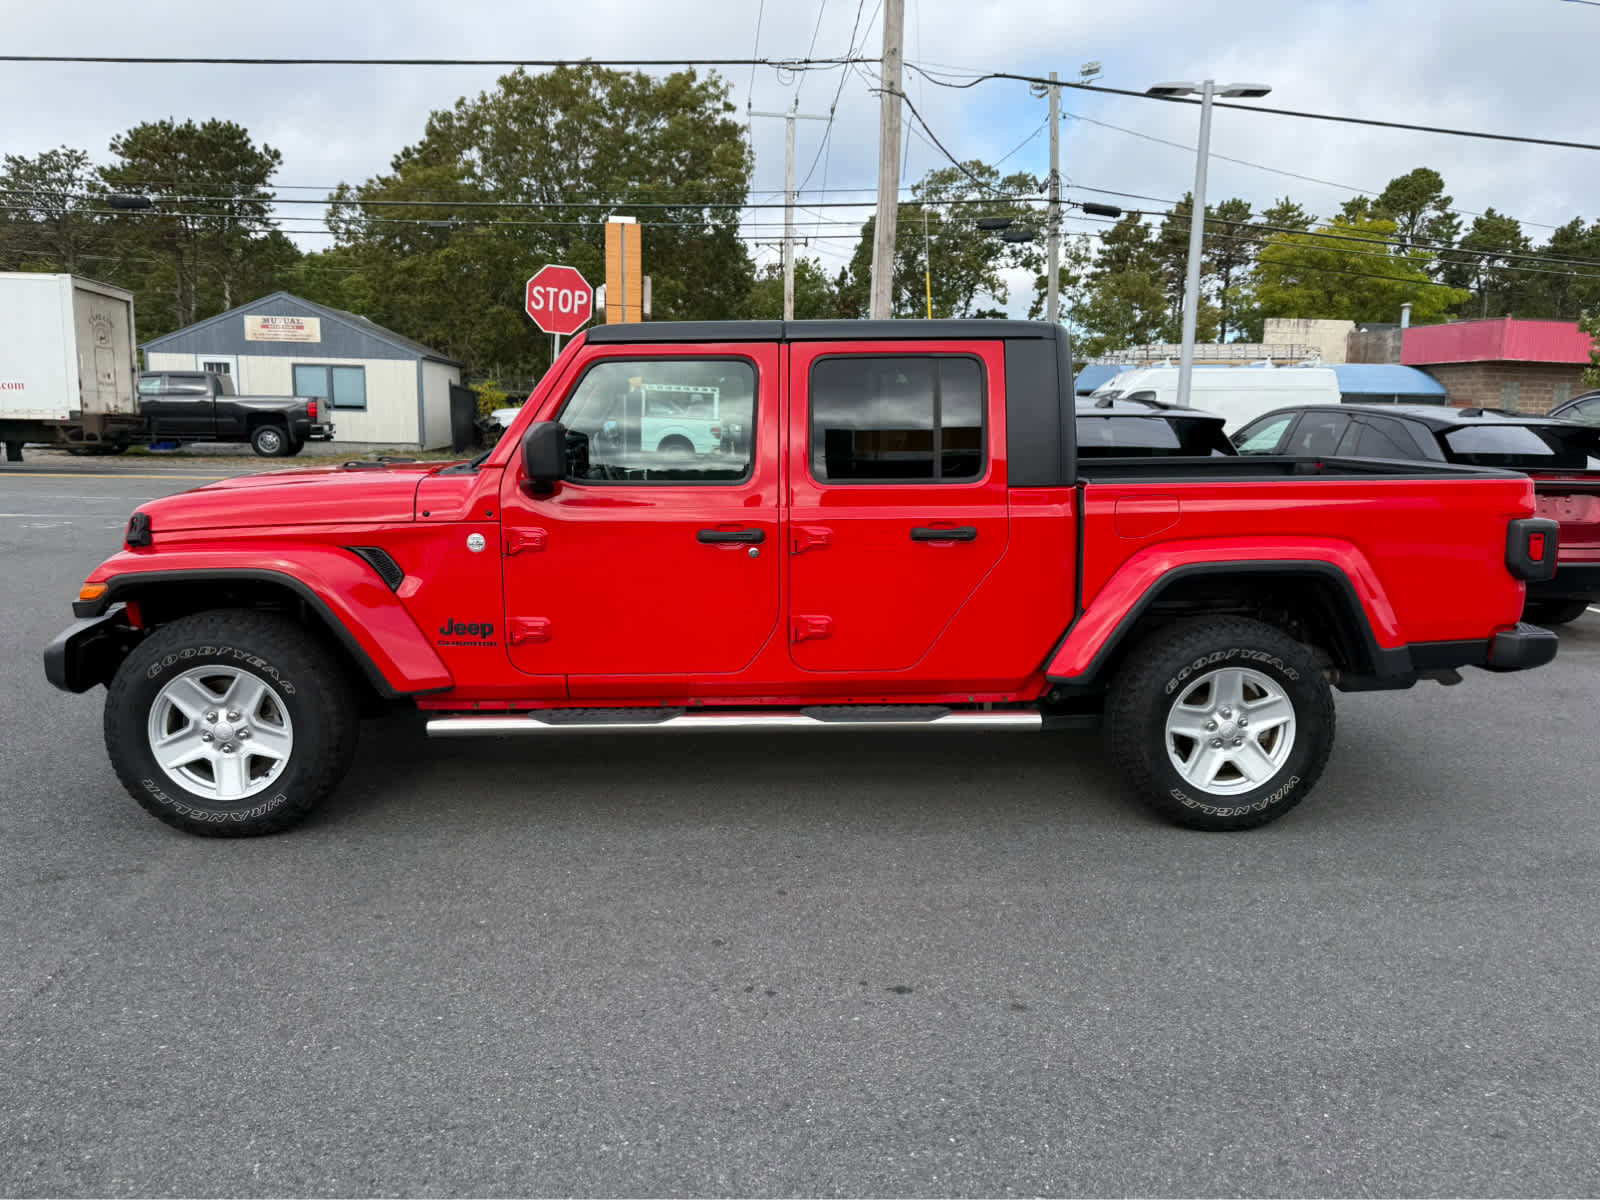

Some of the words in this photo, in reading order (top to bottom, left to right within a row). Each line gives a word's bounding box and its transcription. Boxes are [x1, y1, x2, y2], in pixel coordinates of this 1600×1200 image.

[531, 285, 588, 315] STOP
[439, 617, 495, 639] Jeep
[147, 646, 296, 695] GOODYEAR
[1165, 648, 1300, 694] GOODYEAR
[142, 778, 288, 823] WRANGLER
[1169, 775, 1300, 817] WRANGLER
